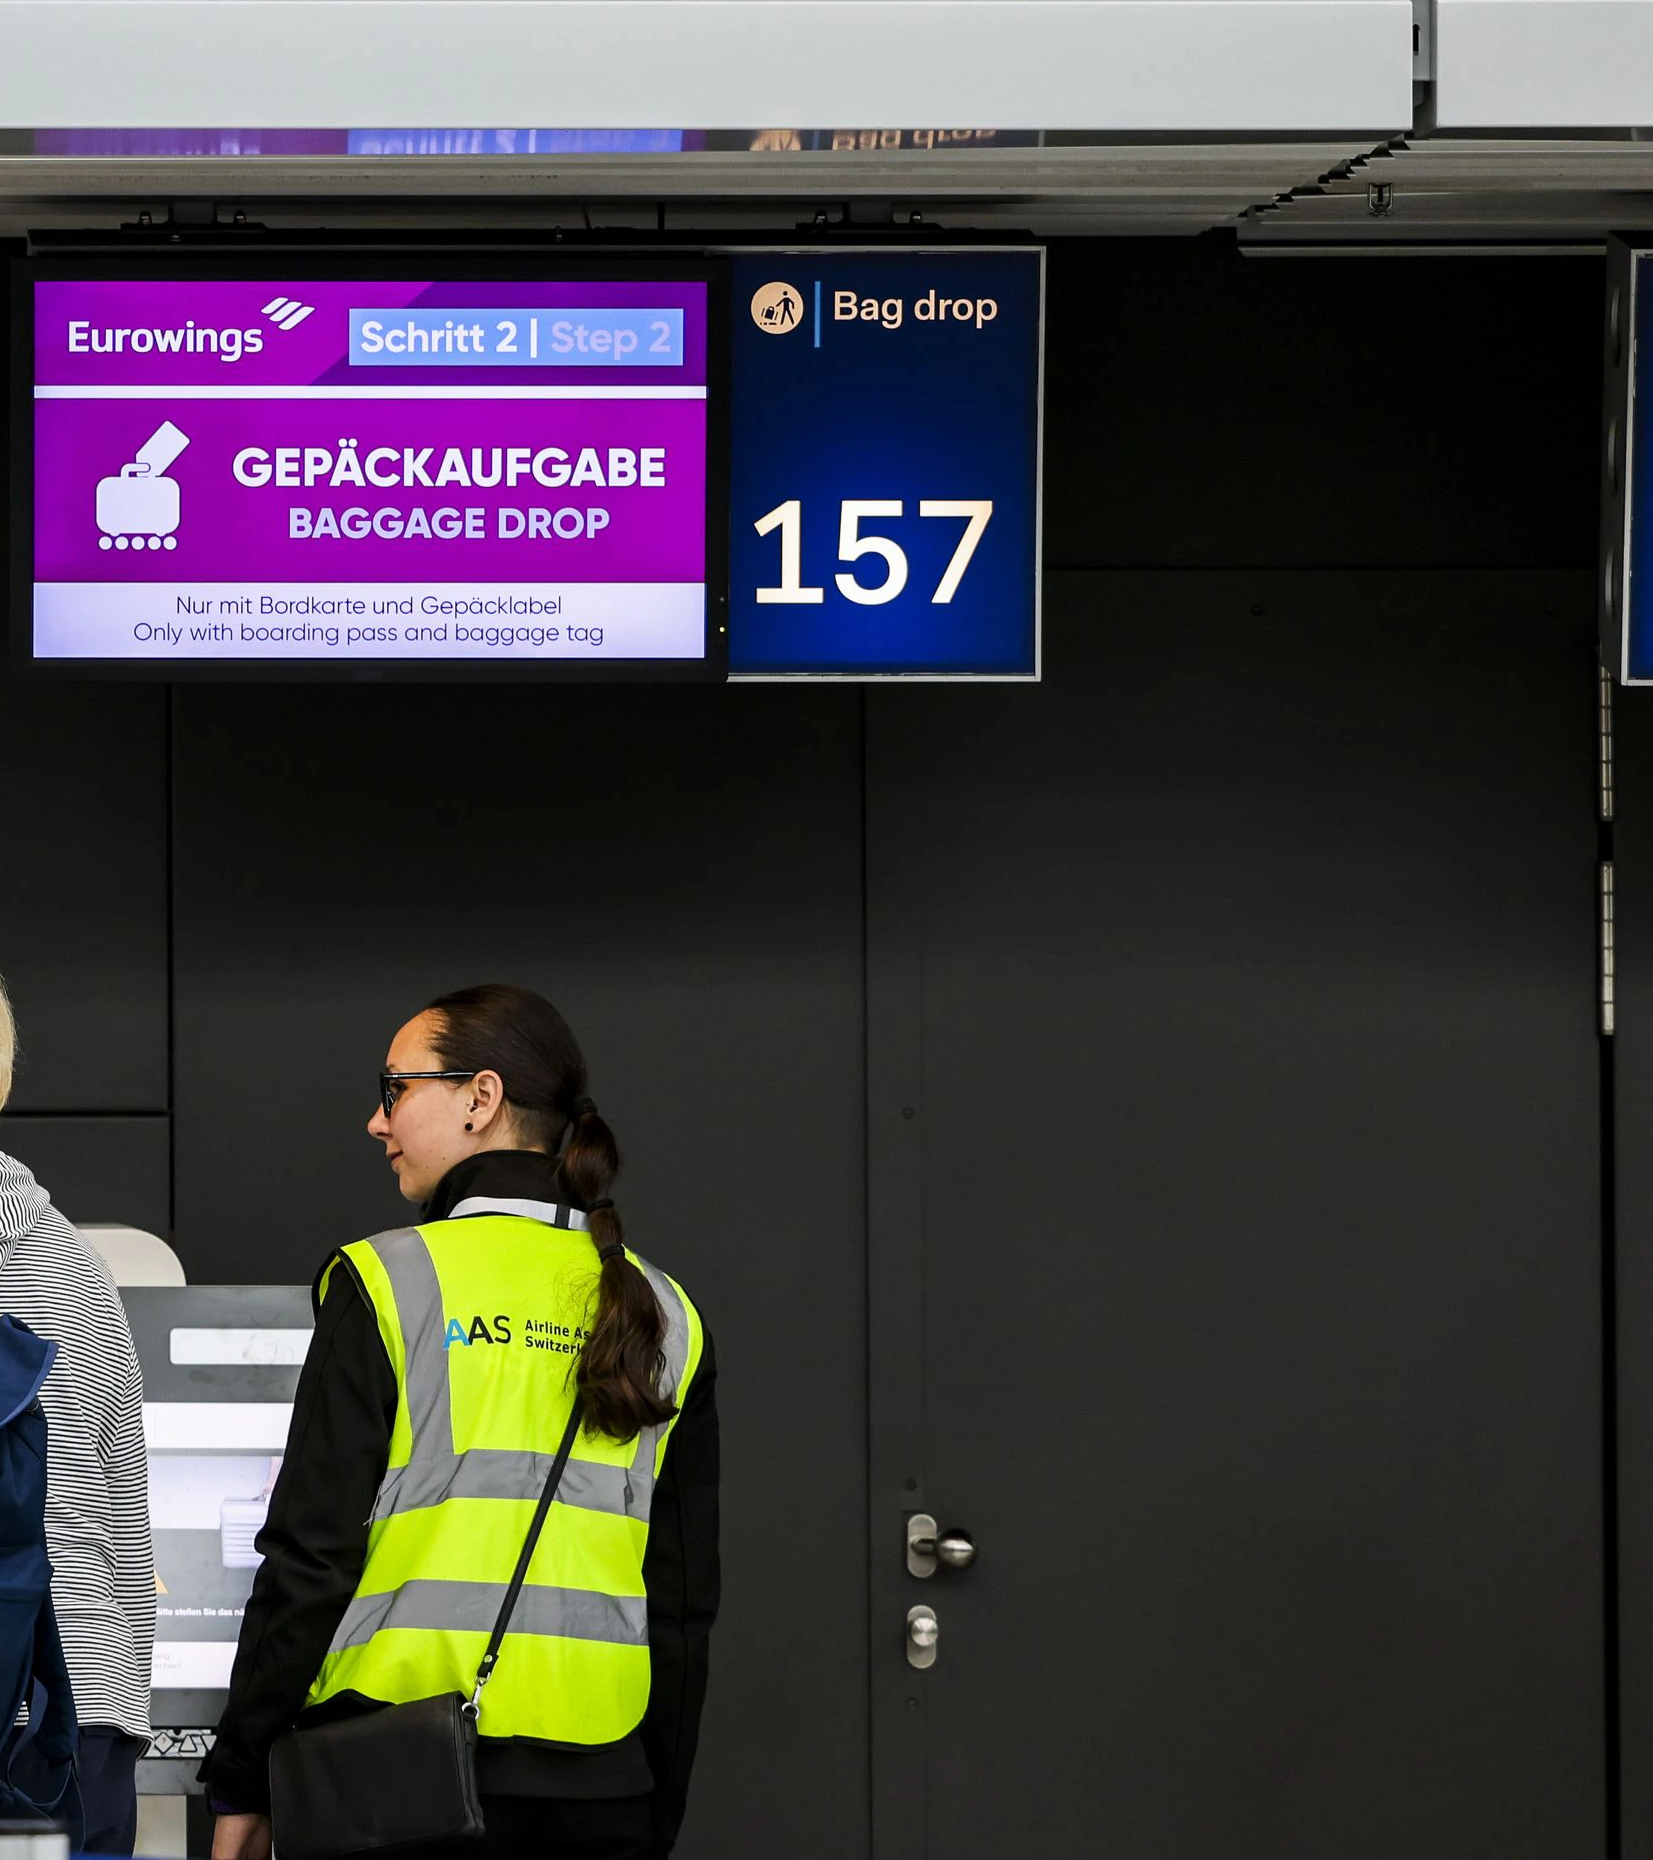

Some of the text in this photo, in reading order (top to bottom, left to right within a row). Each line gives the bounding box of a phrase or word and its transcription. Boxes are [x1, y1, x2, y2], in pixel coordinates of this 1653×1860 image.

[833, 289, 998, 329] Bag drop
[68, 320, 264, 361] Eurowings
[361, 320, 485, 353] Schritt
[496, 321, 518, 353] 2
[551, 321, 638, 360] Step
[649, 321, 672, 353] 2
[232, 438, 666, 488] GEPÄCKAUFGABE
[289, 507, 610, 540] BAGGAGE DROP
[753, 500, 993, 606] 157
[176, 595, 562, 619] Nur mit Bordkarte und Gepäcklabel
[133, 622, 604, 647] Only with boarding pass and baggage tag
[443, 1314, 512, 1350] AAS
[524, 1319, 570, 1338] Airline
[203, 1608, 216, 1616] Sie
[218, 1608, 233, 1616] das
